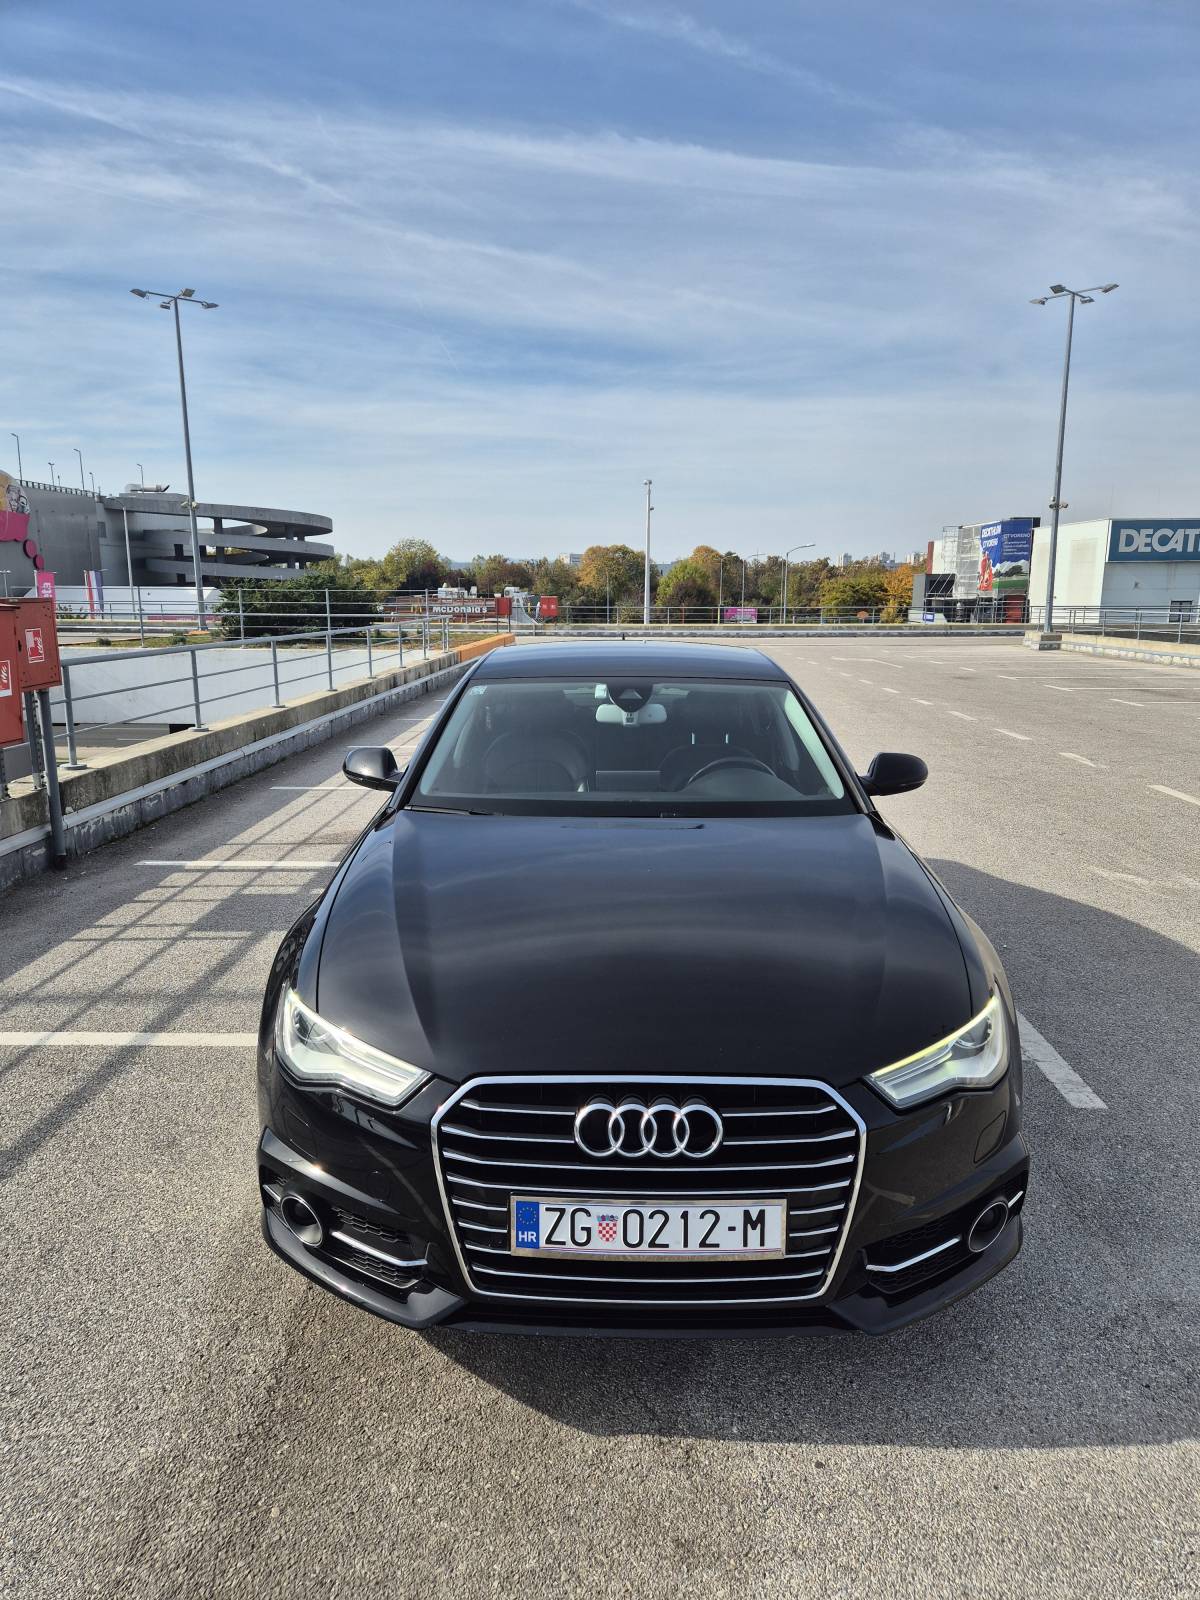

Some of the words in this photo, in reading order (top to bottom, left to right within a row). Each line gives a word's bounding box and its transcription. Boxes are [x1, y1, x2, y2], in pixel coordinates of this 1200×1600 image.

[1118, 528, 1200, 553] DECAT
[518, 1231, 537, 1243] HR
[544, 1206, 592, 1247] ZG
[622, 1208, 767, 1249] 0212-M
